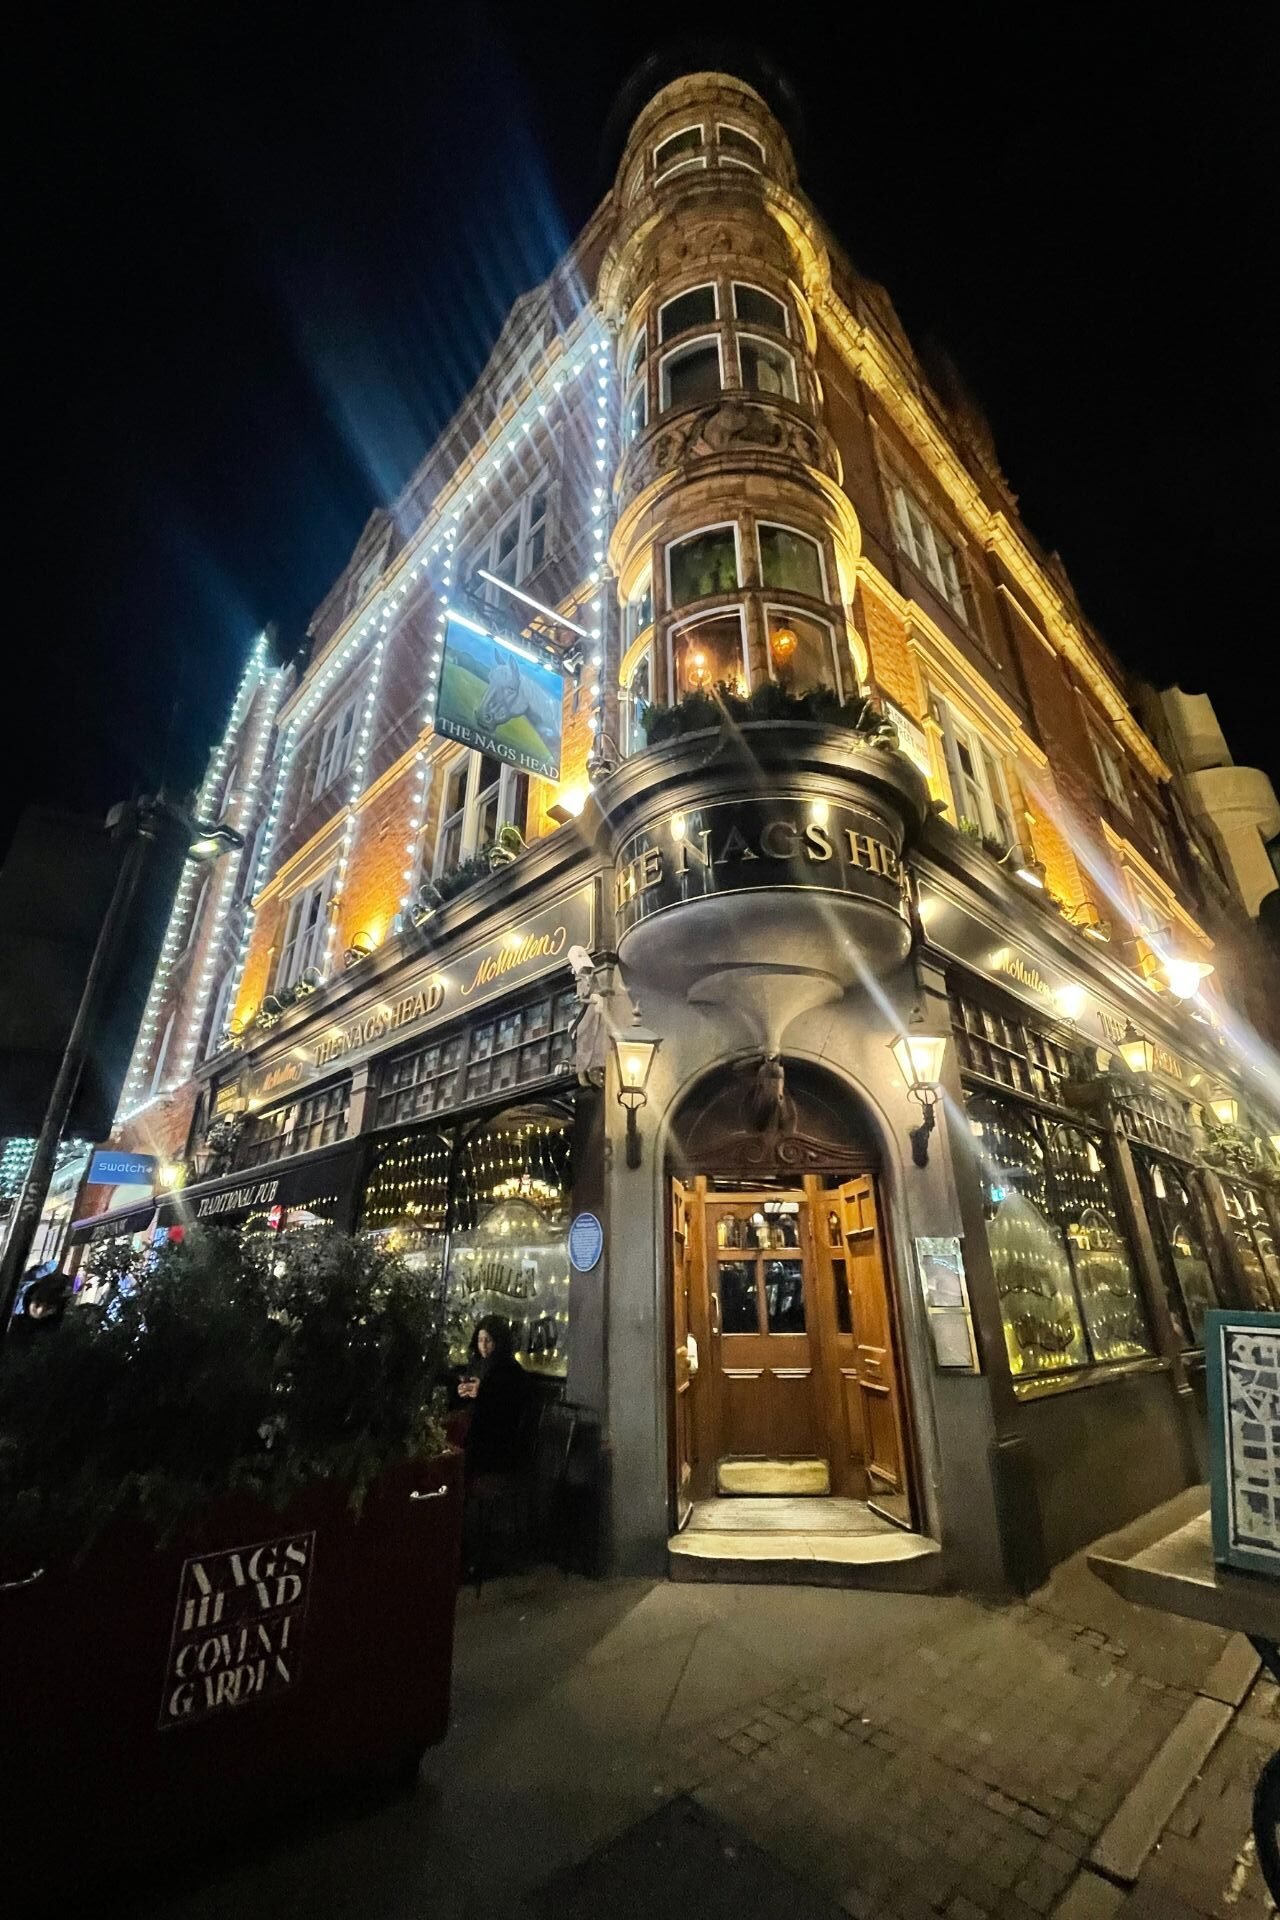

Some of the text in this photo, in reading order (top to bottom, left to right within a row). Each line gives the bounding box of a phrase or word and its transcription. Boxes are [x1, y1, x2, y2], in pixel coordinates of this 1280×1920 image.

[440, 717, 560, 780] THE NAGS HEAD
[675, 820, 833, 875] NAGS
[461, 926, 567, 996] McMullen
[313, 1037, 341, 1068] THE
[388, 983, 447, 1031] HEAD
[98, 1162, 145, 1174] swatch
[196, 1180, 279, 1218] TRADITIONAL PUB
